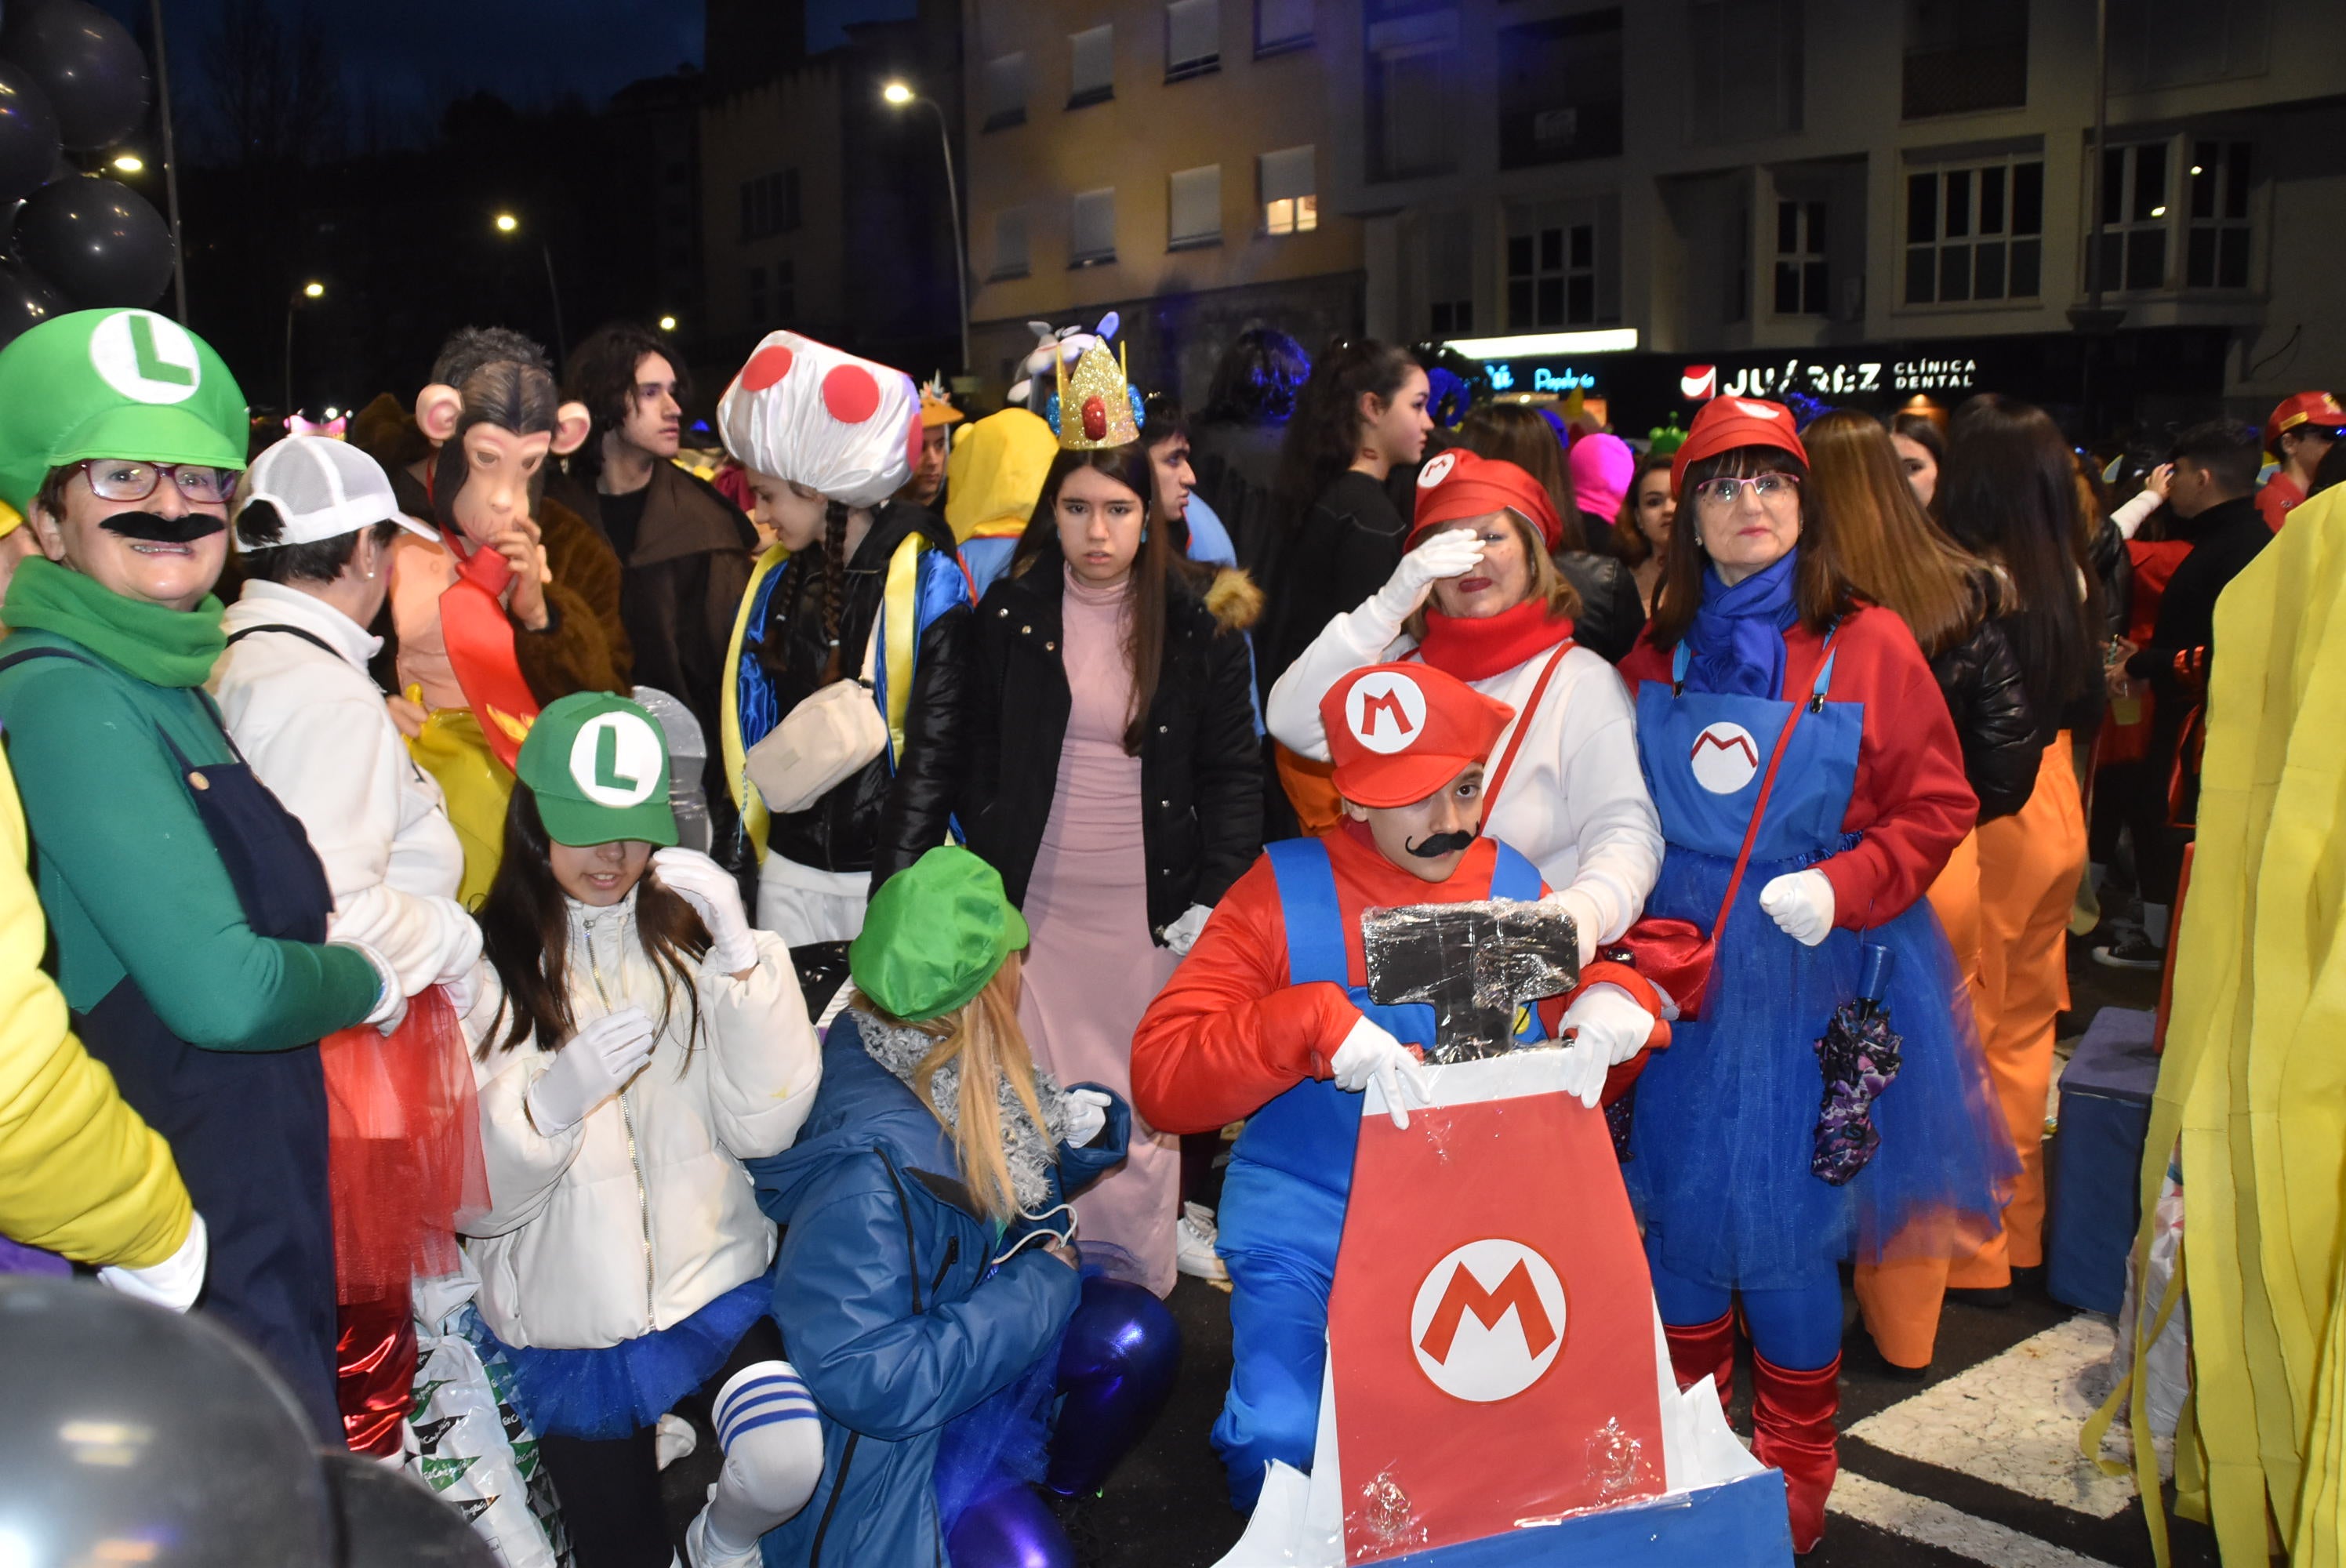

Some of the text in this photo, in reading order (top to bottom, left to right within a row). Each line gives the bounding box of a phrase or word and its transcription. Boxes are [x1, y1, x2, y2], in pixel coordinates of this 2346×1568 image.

[129, 314, 195, 386] L
[1893, 358, 1977, 375] CLÍNICA
[1894, 374, 1974, 390] DENTAL
[1425, 459, 1447, 477] M
[1360, 687, 1414, 736] M
[594, 724, 639, 792] L
[1690, 730, 1758, 768] M
[1419, 1258, 1557, 1365] M
